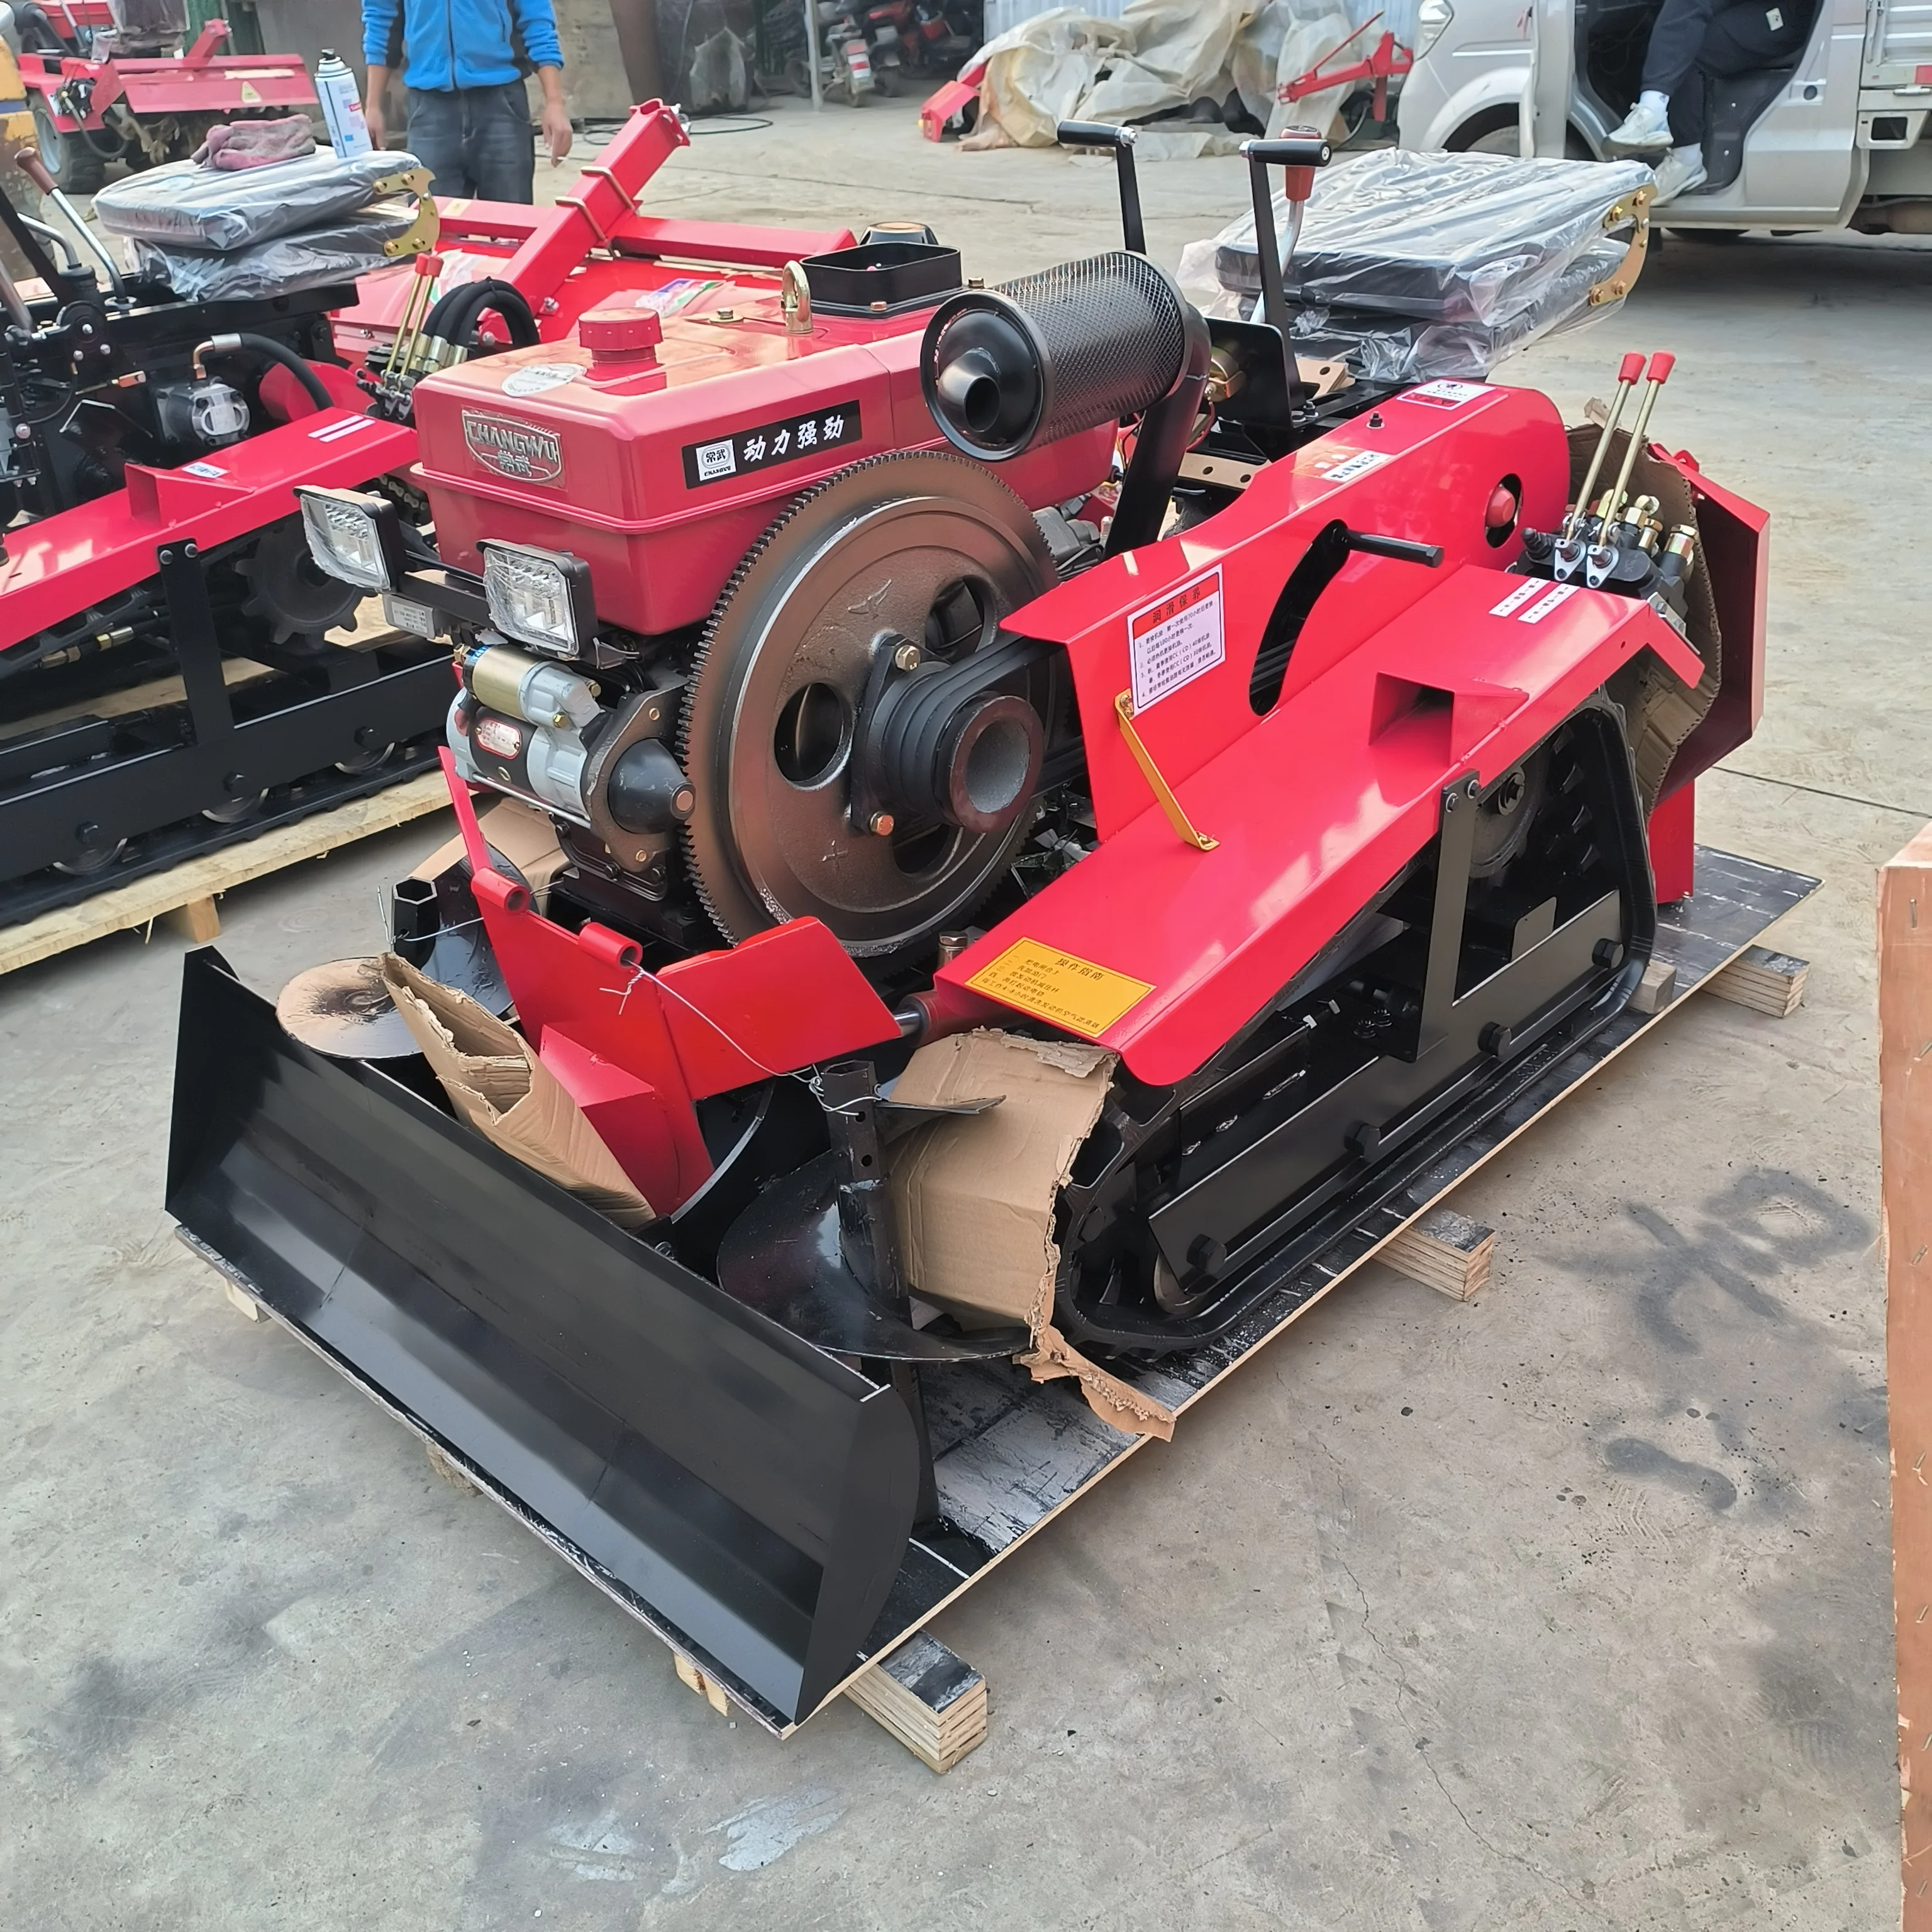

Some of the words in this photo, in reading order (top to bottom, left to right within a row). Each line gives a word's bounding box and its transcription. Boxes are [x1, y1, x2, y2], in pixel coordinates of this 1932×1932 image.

[466, 420, 558, 463] CHANGWU
[706, 448, 726, 464] 常武
[743, 414, 845, 462] 动力强劲
[1152, 585, 1201, 625] 润滑保养
[1053, 957, 1106, 981] 操作指南
